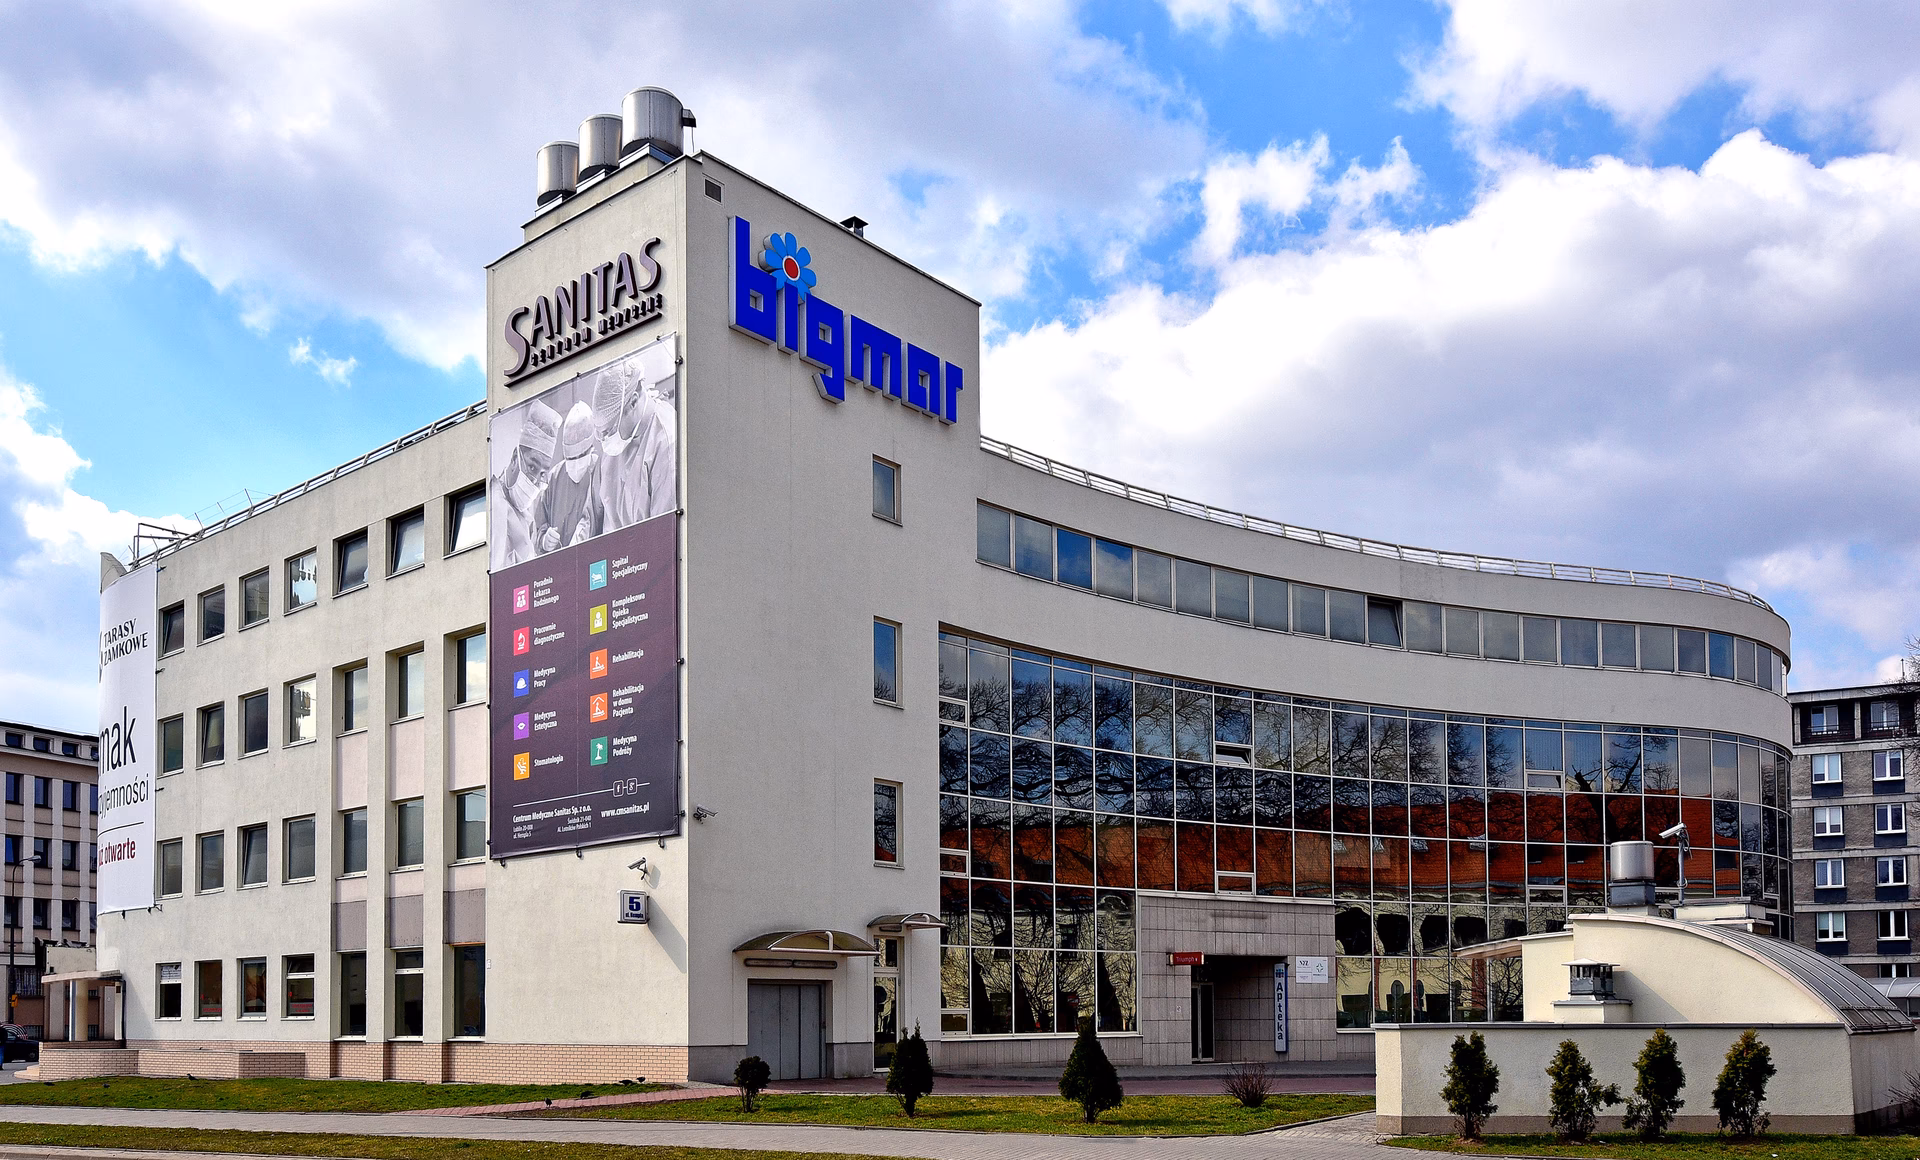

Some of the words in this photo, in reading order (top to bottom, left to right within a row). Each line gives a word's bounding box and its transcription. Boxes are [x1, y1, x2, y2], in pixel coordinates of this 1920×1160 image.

[503, 236, 662, 378] SANITAS
[728, 215, 964, 426] bigmar
[530, 326, 592, 367] CENTRUM
[597, 292, 663, 336] MEDYCZNE
[612, 555, 629, 569] Szpital
[612, 562, 648, 580] Specjalistyczny
[533, 576, 553, 589] Poradnia
[533, 587, 551, 599] Lekarza
[612, 592, 646, 608] Kompleksowa
[533, 594, 560, 608] Rodzinnego
[612, 607, 630, 619] Opieka
[612, 612, 649, 630] Specjalistyczna
[103, 618, 137, 648] TARASY
[533, 622, 557, 635] Pracownie
[533, 631, 565, 645] diagnostyczne
[103, 631, 149, 667] ZAMKOWE
[612, 648, 644, 664] Rehabilitacja
[533, 666, 556, 678] Medycyna
[533, 679, 547, 688] Pracy
[612, 683, 645, 698] Rehabilitacja
[618, 697, 633, 705] domu
[534, 710, 557, 721] Medycyna
[612, 706, 634, 718] Pacjenta
[534, 720, 558, 731] Estetyczna
[612, 735, 638, 746] Medycyna
[612, 746, 633, 757] Podróży
[533, 754, 564, 767] Stomatologia
[512, 814, 532, 823] Centrum
[531, 810, 554, 821] Medyczne
[554, 807, 572, 817] Sanitas
[571, 805, 580, 815] Sp.
[582, 804, 592, 812] o.o.
[601, 802, 649, 817] www.cmsanitas.pl
[104, 837, 136, 864] otwarte
[629, 896, 641, 911] 5
[1276, 982, 1284, 1041] Apteka
